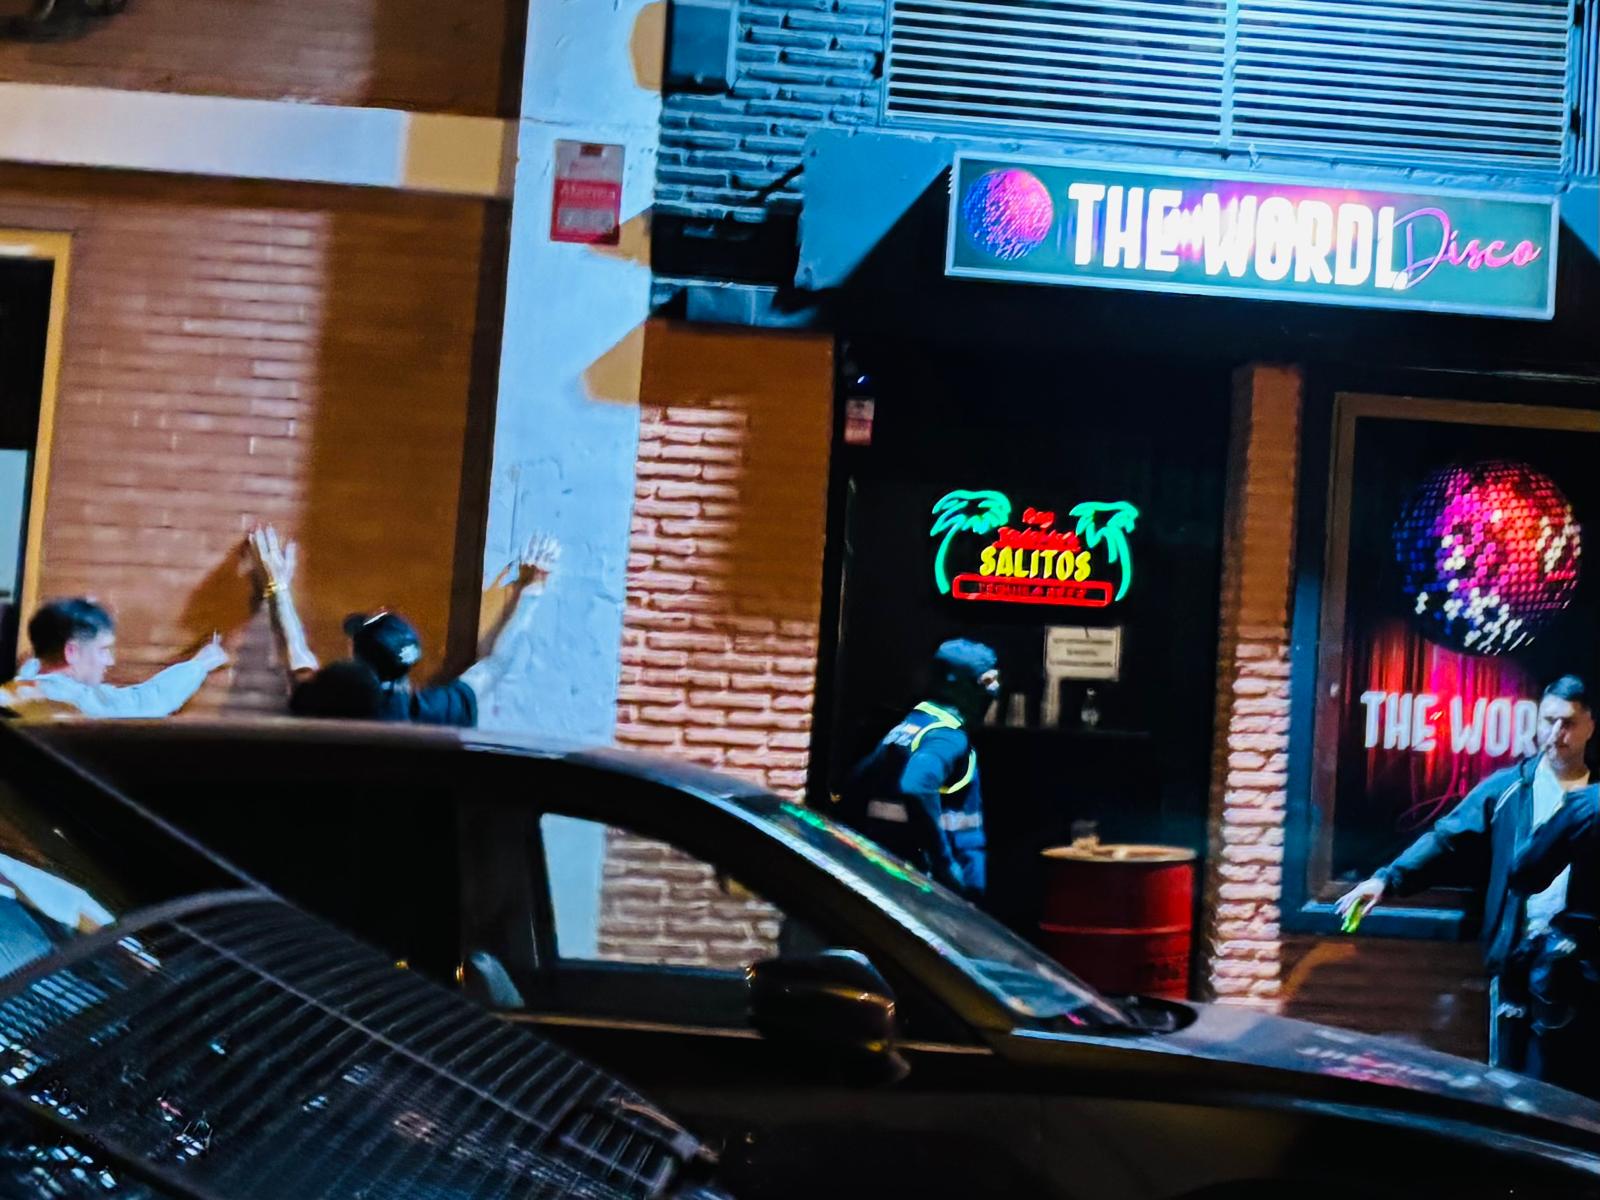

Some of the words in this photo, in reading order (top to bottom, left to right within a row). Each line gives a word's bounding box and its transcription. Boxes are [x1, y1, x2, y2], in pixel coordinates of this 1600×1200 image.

[1067, 182, 1183, 273] THE
[1201, 192, 1408, 290] WORDL
[1393, 207, 1542, 290] Disco
[978, 545, 1092, 583] SALITOS
[1360, 690, 1439, 752] THE
[1449, 695, 1539, 758] WOR
